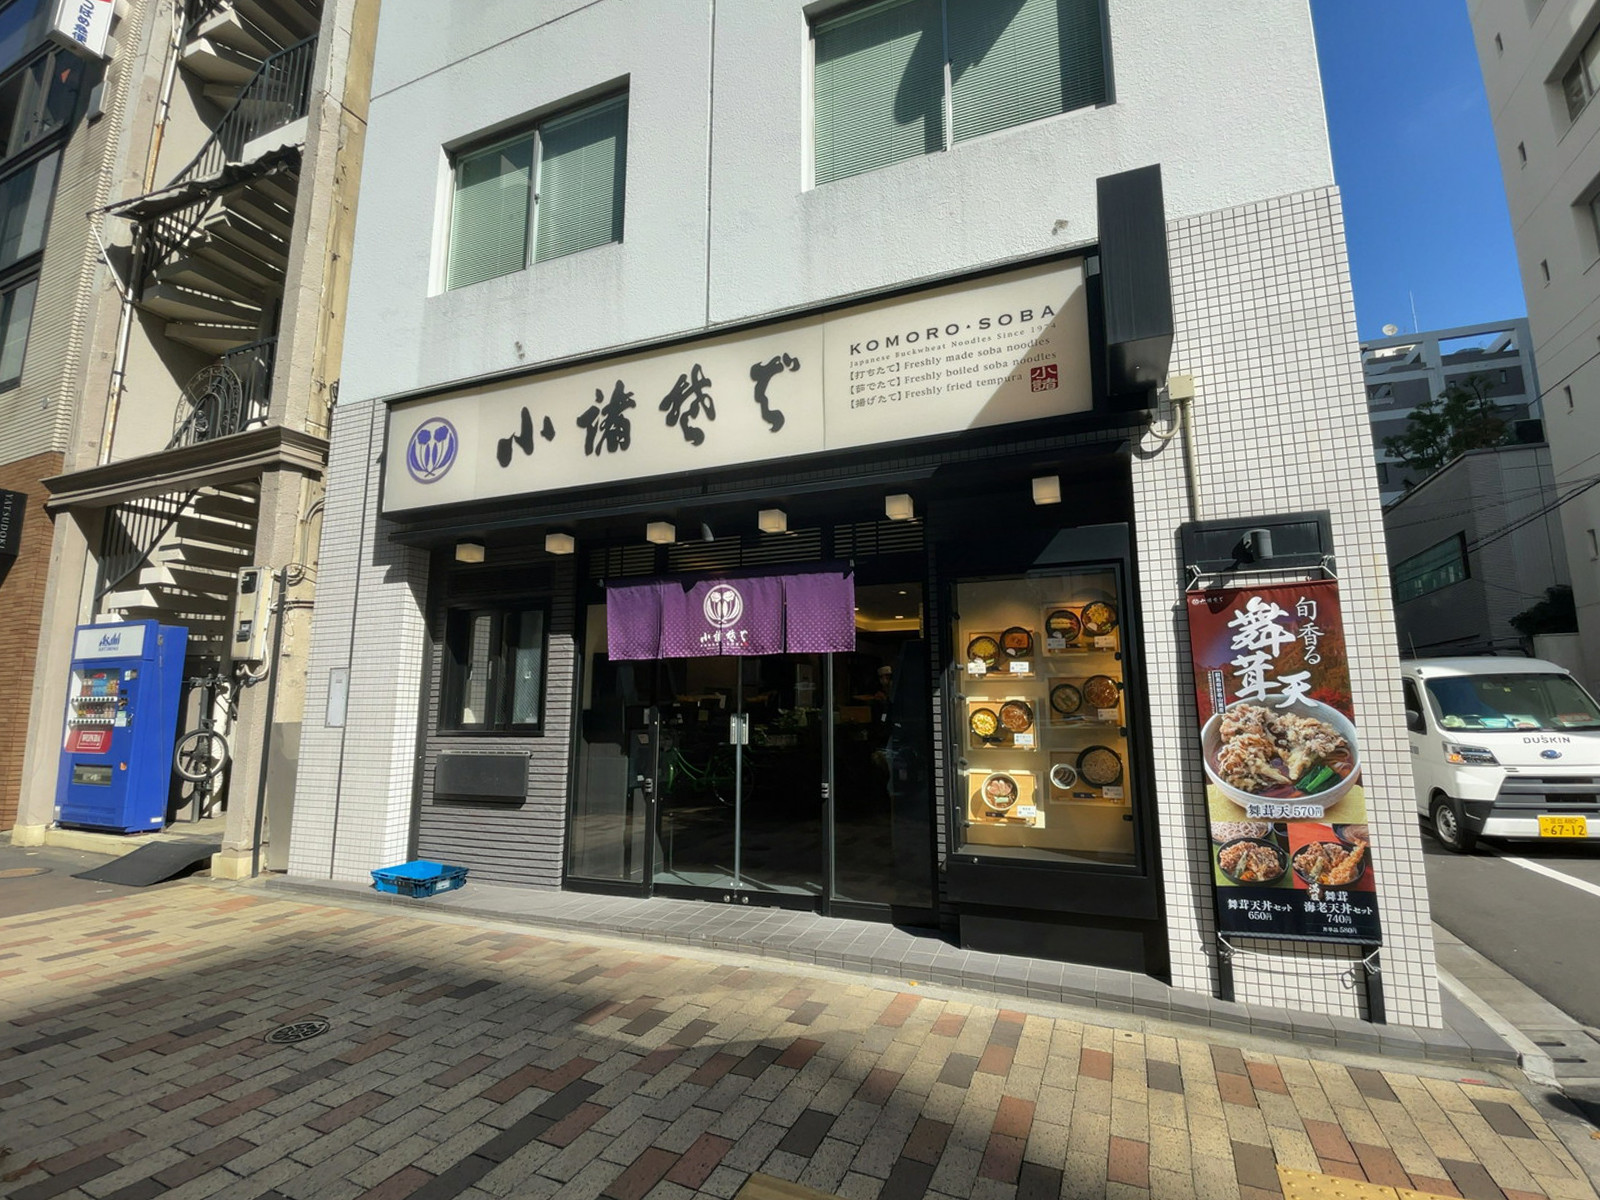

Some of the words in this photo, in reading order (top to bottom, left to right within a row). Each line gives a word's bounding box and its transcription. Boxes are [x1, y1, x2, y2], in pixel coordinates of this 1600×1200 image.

[849, 355, 891, 369] Japanese
[895, 344, 946, 358] Buckwheat
[951, 335, 992, 348] Noodles
[997, 329, 1025, 340] Since
[904, 356, 942, 370] Freshly
[945, 351, 974, 363] made
[977, 346, 1002, 356] soba
[1006, 338, 1051, 352] noodles
[904, 371, 942, 385] Freshly
[946, 364, 979, 377] boiled
[983, 360, 1008, 371] soba
[1012, 351, 1057, 366] noodles
[905, 385, 943, 399] Freshly
[946, 380, 972, 392] fried
[976, 374, 1023, 387] tempura
[1295, 596, 1325, 665] 旬香る
[98, 632, 121, 647] Asahi
[1523, 735, 1571, 744] DUSKIN
[1248, 804, 1290, 817] 舞茸天
[1293, 806, 1323, 817] 570円
[1551, 825, 1585, 836] 67-12
[1324, 890, 1348, 902] 舞茸
[1227, 898, 1293, 912] 舞茸天丼セット
[1304, 901, 1373, 915] 海老天丼セット
[1247, 911, 1272, 921] 650円
[1326, 914, 1352, 924] 740円
